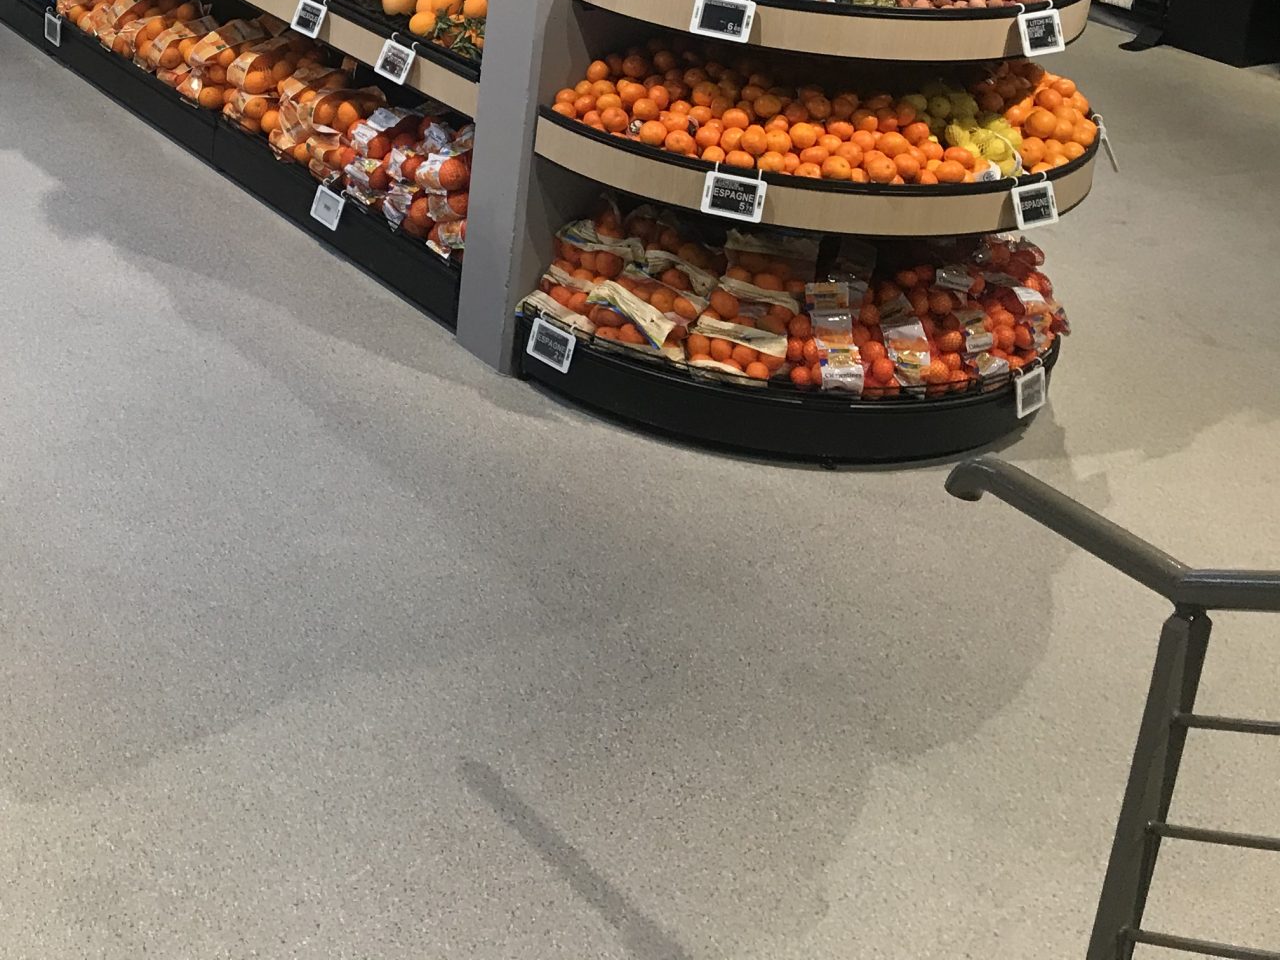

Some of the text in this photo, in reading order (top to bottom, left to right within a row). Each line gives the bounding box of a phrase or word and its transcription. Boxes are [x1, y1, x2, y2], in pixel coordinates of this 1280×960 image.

[714, 187, 755, 203] ESPAGNE
[1021, 197, 1049, 210] ESPAGNE
[824, 371, 863, 380] Clémentines
